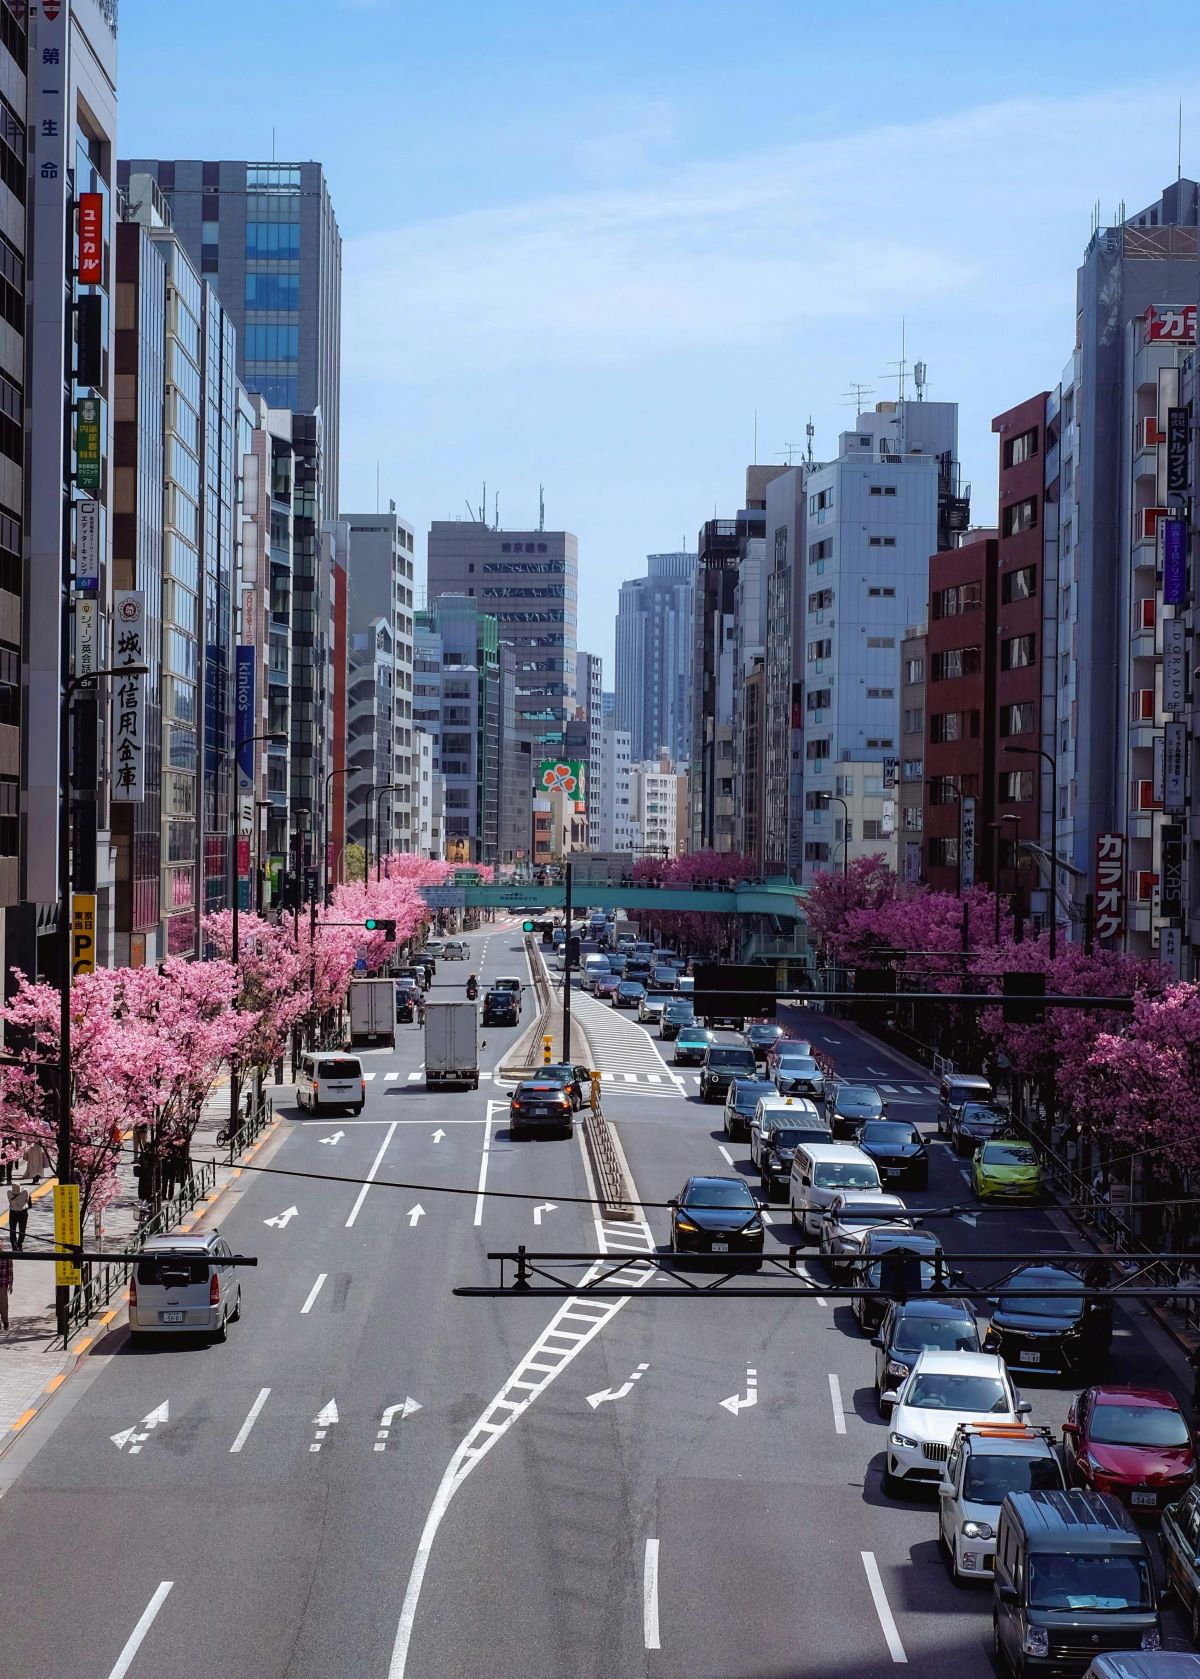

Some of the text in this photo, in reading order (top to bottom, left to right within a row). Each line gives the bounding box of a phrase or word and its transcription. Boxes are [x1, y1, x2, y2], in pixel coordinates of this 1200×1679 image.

[40, 48, 60, 180] 第一生命
[83, 209, 100, 270] ユニカル
[83, 477, 93, 485] 7F
[81, 579, 92, 587] 6F
[81, 615, 92, 674] シェーン英会話
[238, 662, 252, 711] kinko's
[1096, 834, 1122, 938] カラオケ
